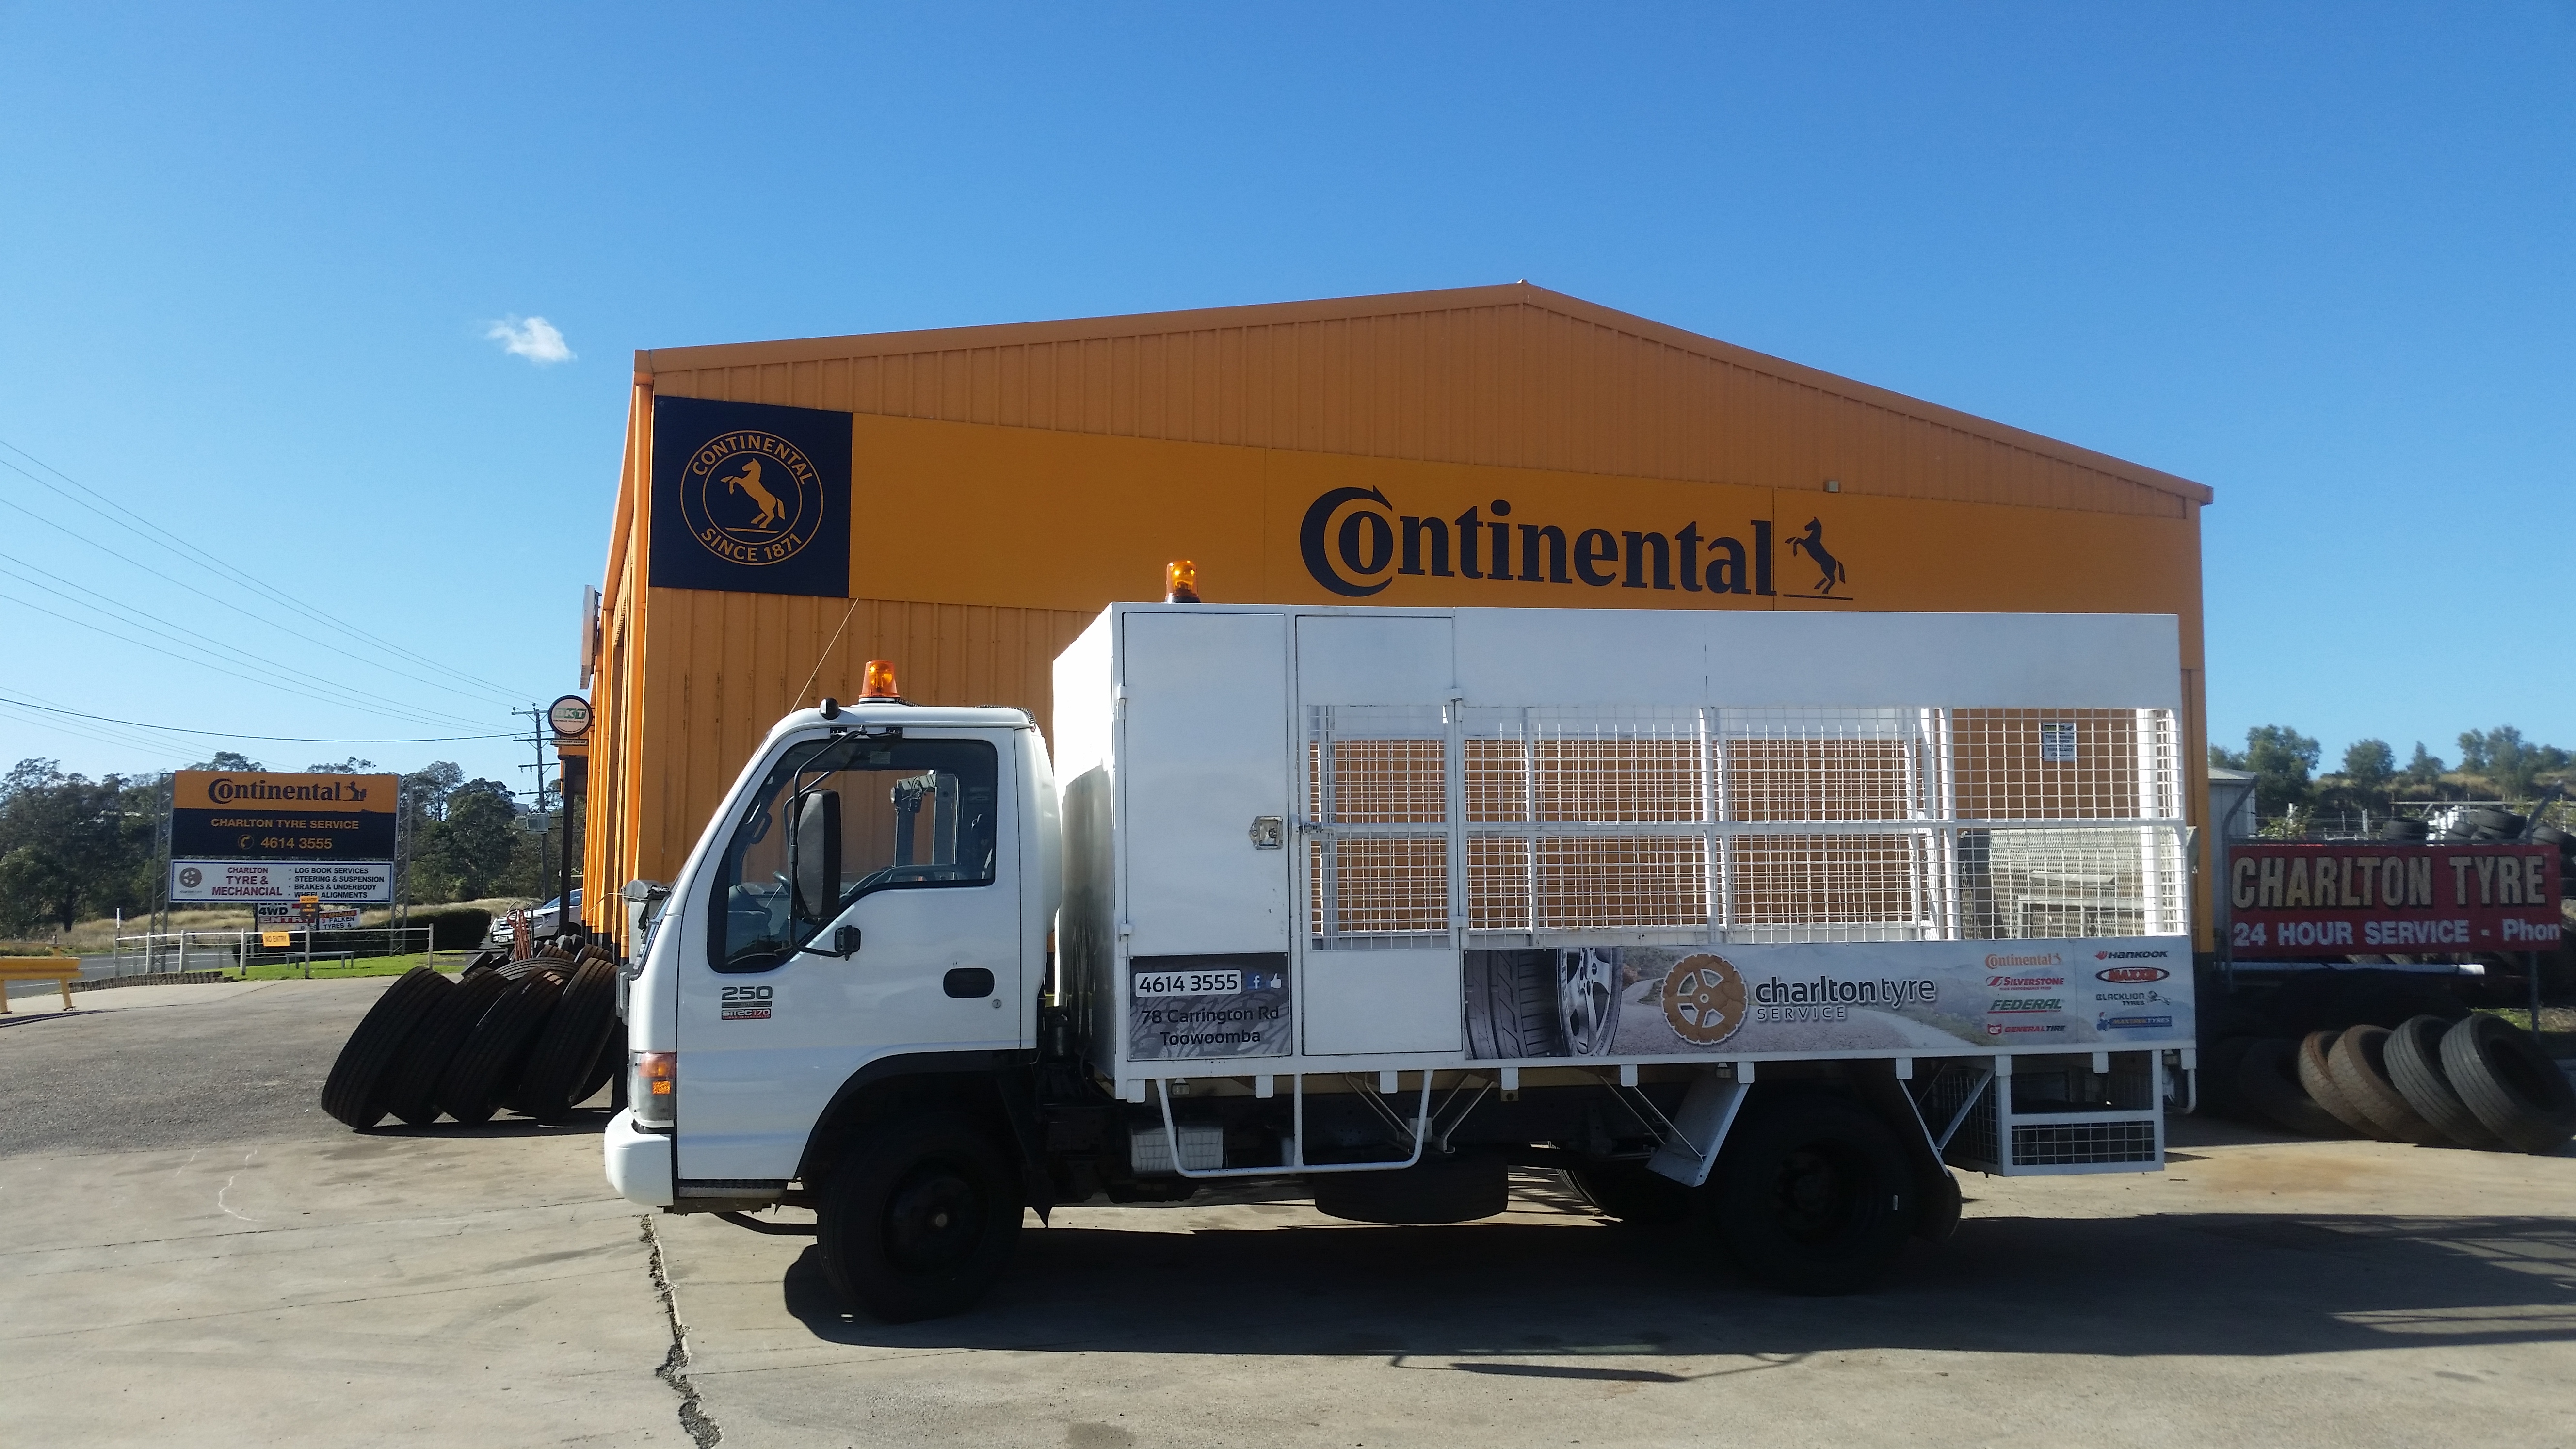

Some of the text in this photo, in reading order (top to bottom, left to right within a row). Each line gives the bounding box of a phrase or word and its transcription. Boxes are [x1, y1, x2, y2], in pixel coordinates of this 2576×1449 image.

[692, 435, 812, 484] CONTINENTAL
[701, 528, 802, 561] SINCE 1871
[1300, 485, 1777, 597] Continental
[555, 708, 586, 718] BKT
[209, 778, 341, 804] Continental
[211, 818, 359, 829] CHARLTON TYRE SERVICE
[260, 837, 333, 849] 4614 3555
[226, 876, 268, 885] TYRE &
[2231, 855, 2547, 909] CHARLTON TYRE
[212, 886, 283, 896] MECHANCIAL
[2233, 922, 2267, 947] 24
[2278, 922, 2353, 946] HOUR
[2364, 920, 2470, 945] SERVICE
[1985, 953, 2052, 969] Continental
[1139, 976, 1186, 993] 4614
[1191, 974, 1238, 992] 3555
[721, 986, 773, 1000] 250
[2096, 993, 2144, 1001] BLACKLION
[1990, 999, 2062, 1010] FEDERAL
[1141, 1006, 1280, 1024] 78 Carrington Rd
[1757, 1007, 1845, 1019] SERVICE
[1160, 1030, 1261, 1046] Toowoomba
